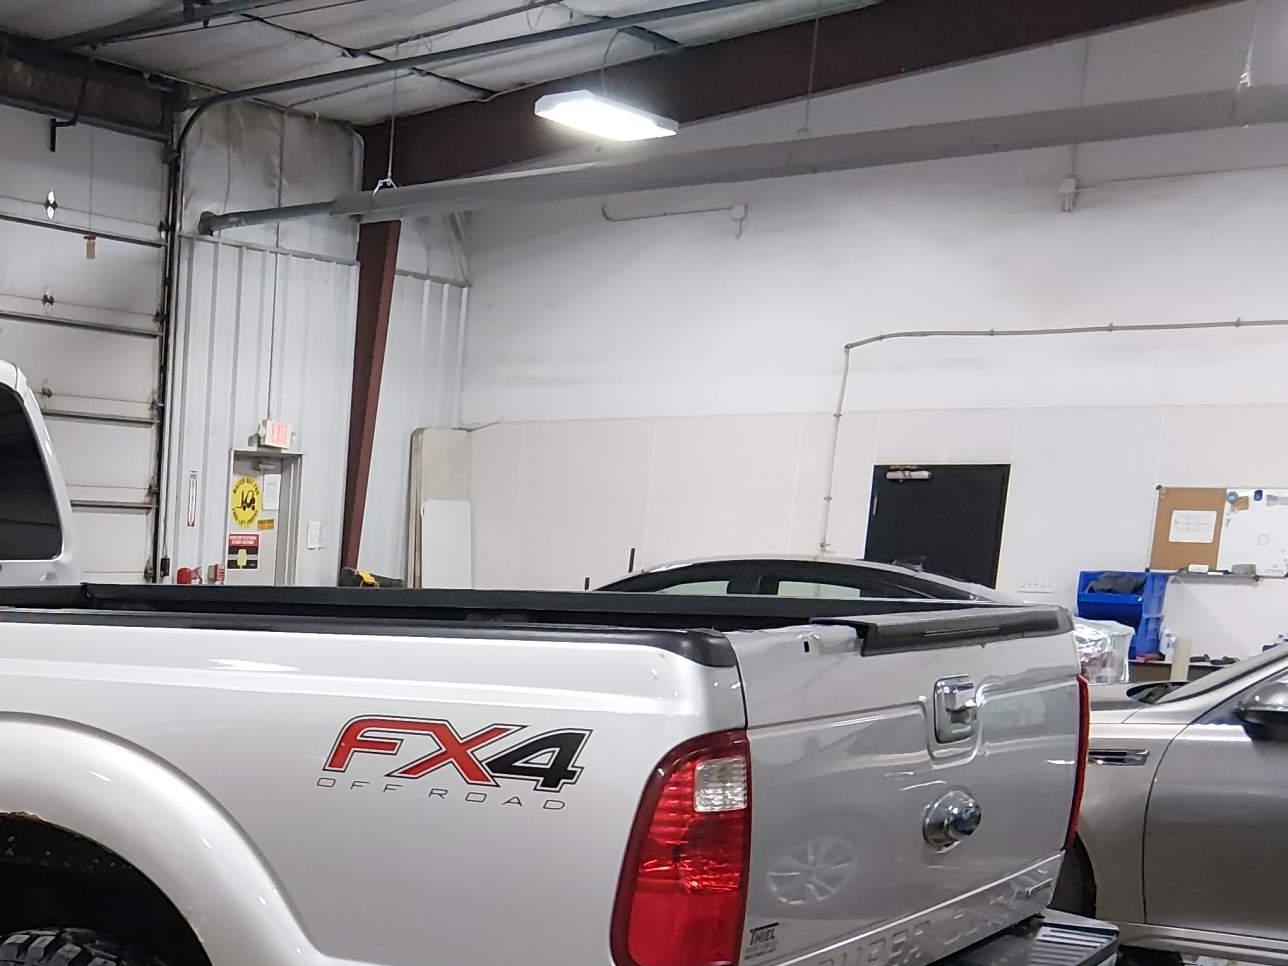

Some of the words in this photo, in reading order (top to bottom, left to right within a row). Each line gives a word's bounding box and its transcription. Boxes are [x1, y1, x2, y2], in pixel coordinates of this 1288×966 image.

[322, 714, 593, 793] FX4
[316, 777, 403, 793] OFF
[428, 788, 566, 810] ROAD
